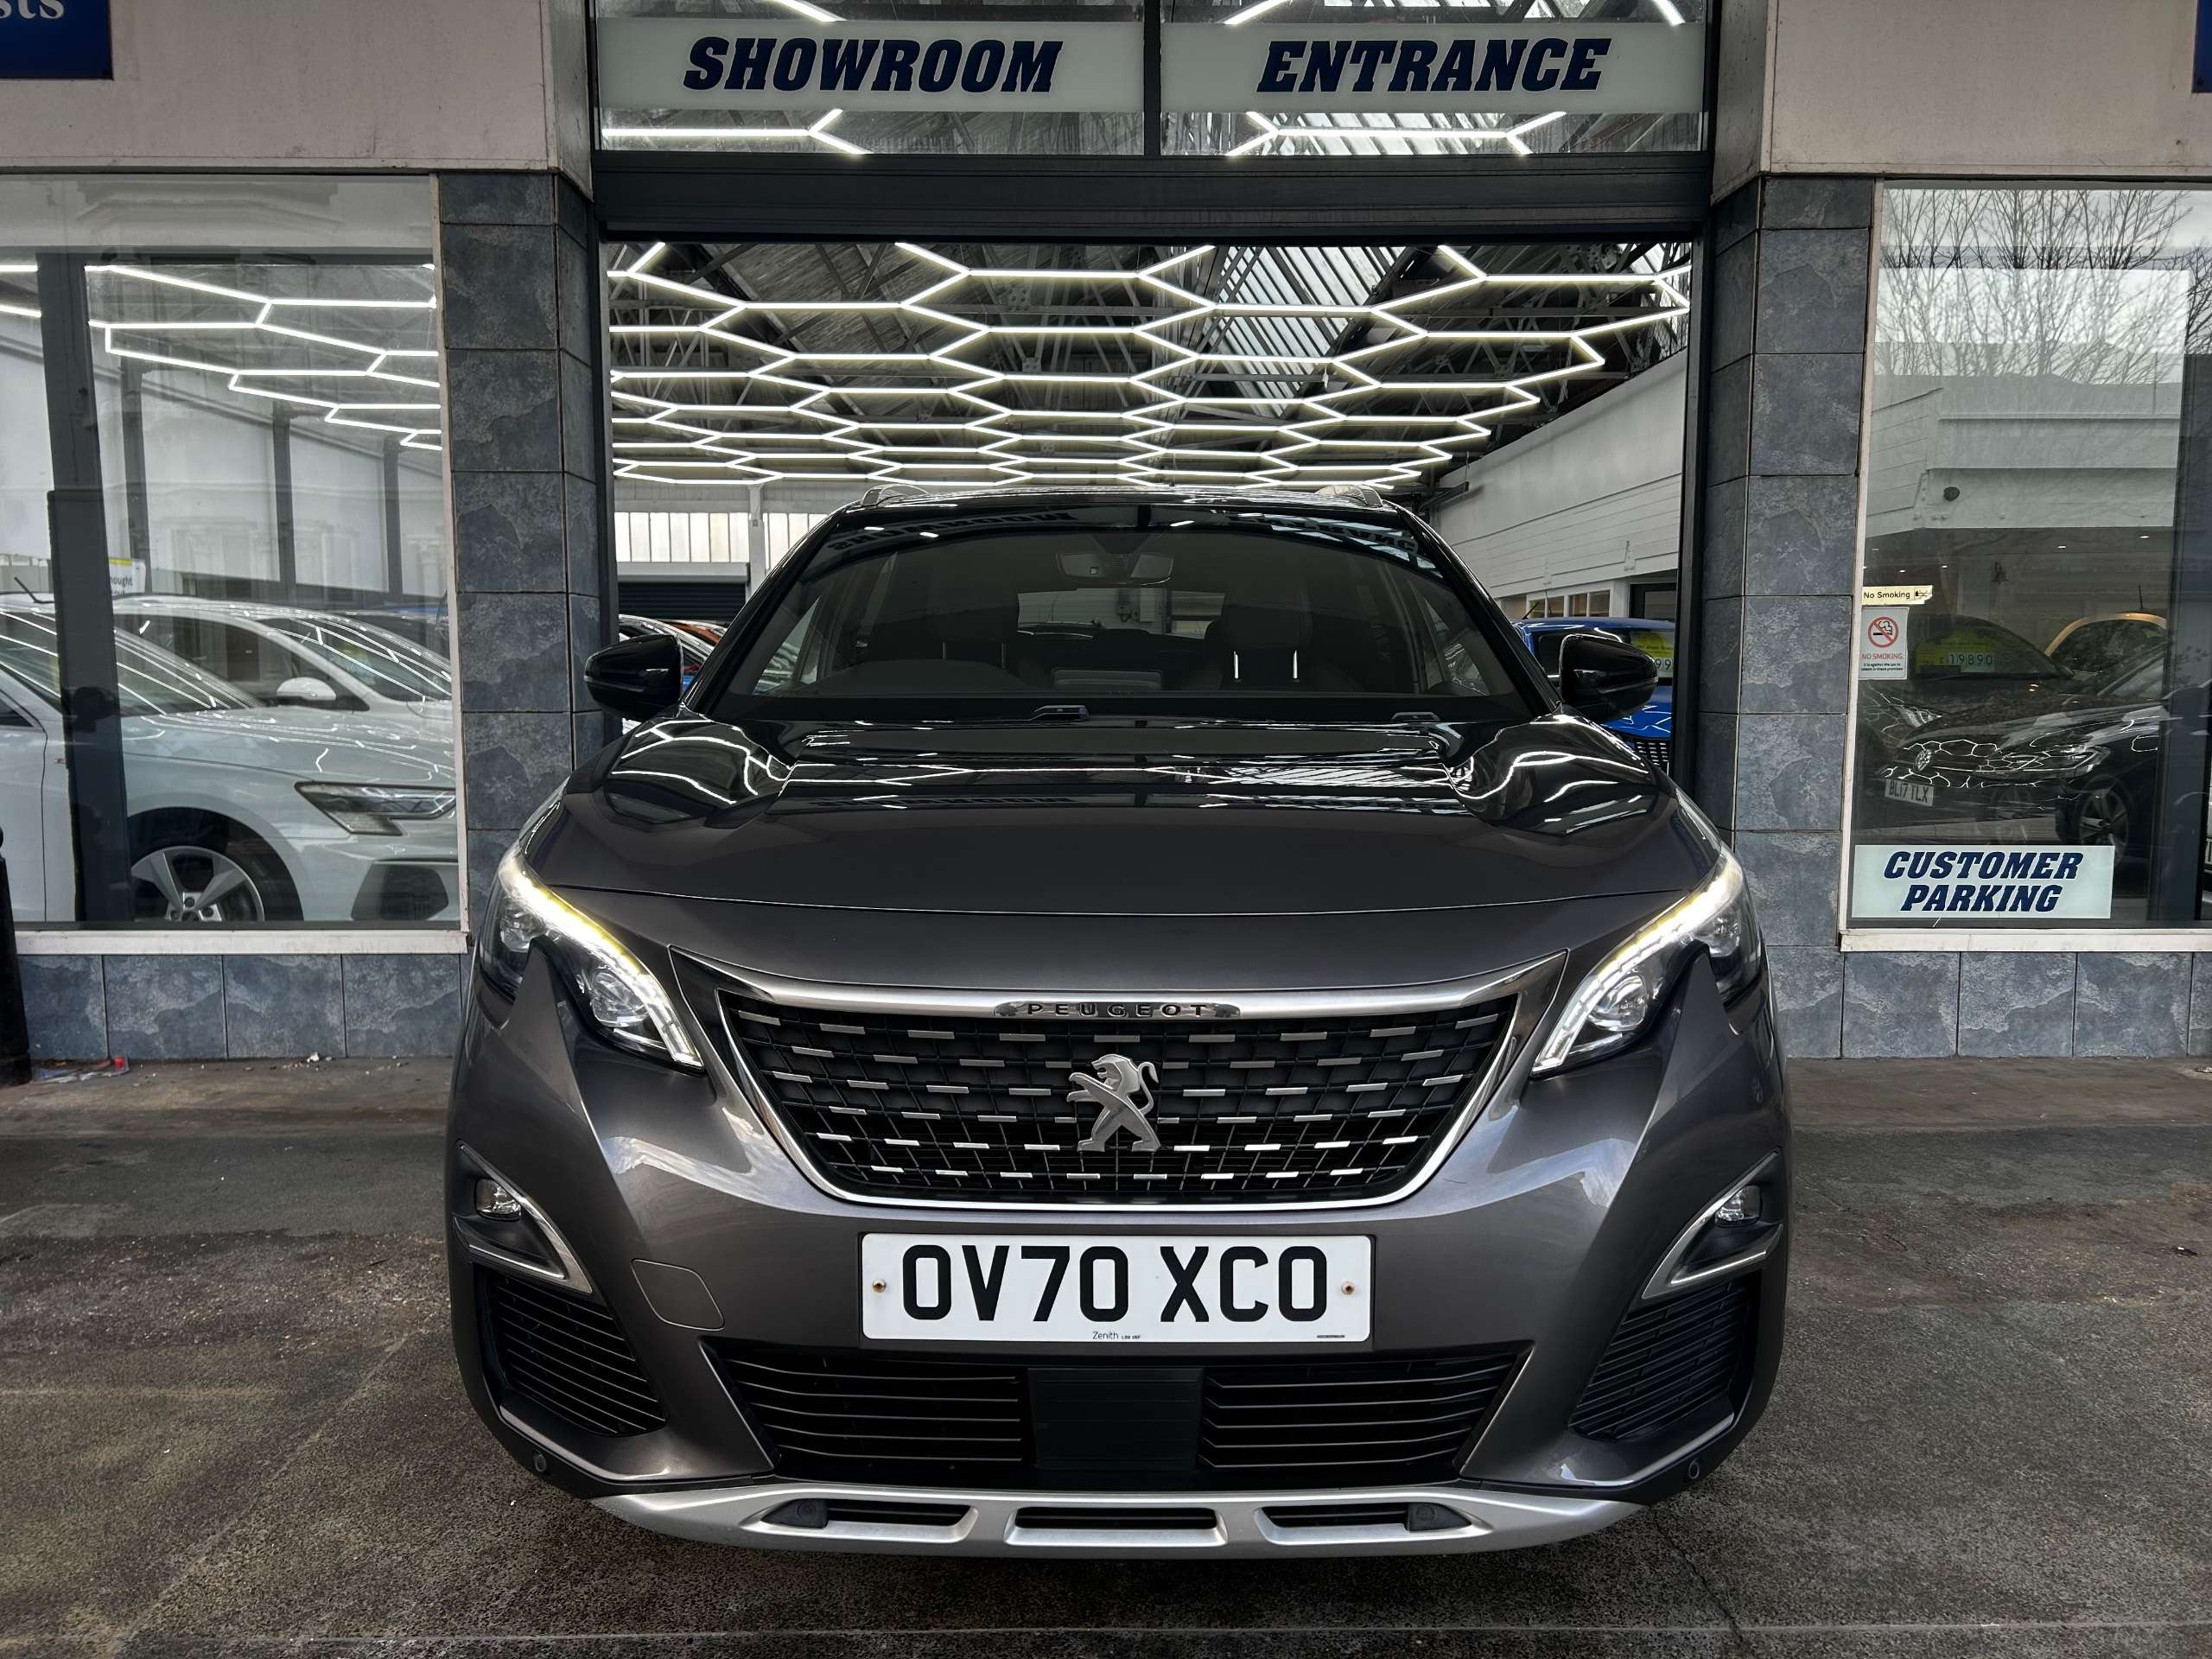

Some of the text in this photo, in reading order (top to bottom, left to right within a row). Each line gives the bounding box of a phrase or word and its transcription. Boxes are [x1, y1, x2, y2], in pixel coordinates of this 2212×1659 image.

[683, 36, 1064, 92] SHOWROOM
[1256, 38, 1611, 92] ENTRANCE
[1877, 591, 1910, 600] Smoking
[1910, 785, 1929, 803] TLX
[1884, 851, 2084, 880] CUSTOMER
[1900, 885, 2063, 912] PARKING
[1027, 1003, 1206, 1017] PEUGEOT
[902, 1244, 1328, 1323] OV70 XCO
[1092, 1331, 1119, 1340] Zenith
